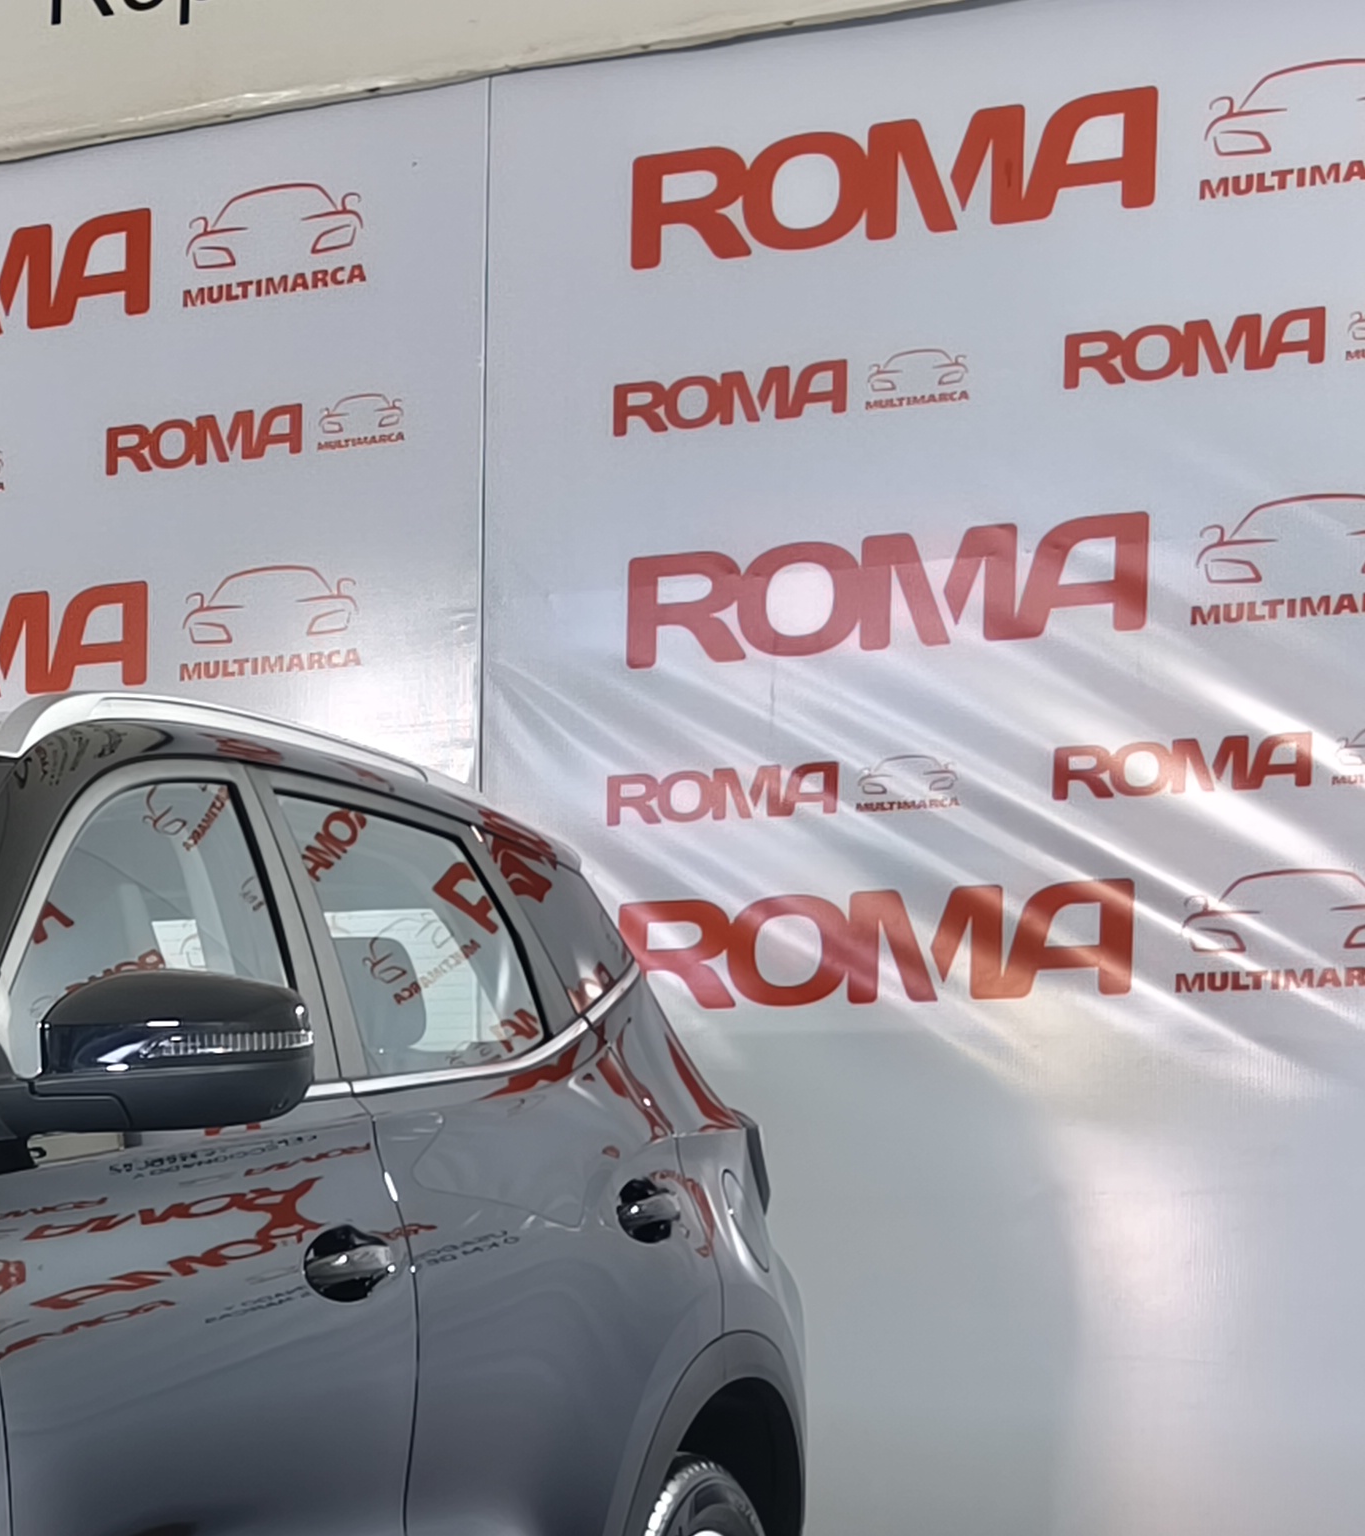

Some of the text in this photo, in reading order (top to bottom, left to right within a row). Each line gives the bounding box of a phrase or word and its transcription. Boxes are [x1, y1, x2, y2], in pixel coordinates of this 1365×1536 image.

[630, 86, 1159, 271] ROMA
[183, 264, 367, 308] MULTIMARCA
[1064, 306, 1327, 390] ROMA
[613, 359, 848, 437] ROMA
[106, 403, 303, 477] ROMA
[628, 511, 1150, 669] ROMA
[1190, 593, 1365, 626] MULTIMA
[179, 648, 362, 683] MULTIMARCA
[607, 761, 840, 826] ROMA
[1052, 731, 1313, 802] ROMA
[616, 878, 1135, 1010] ROMA
